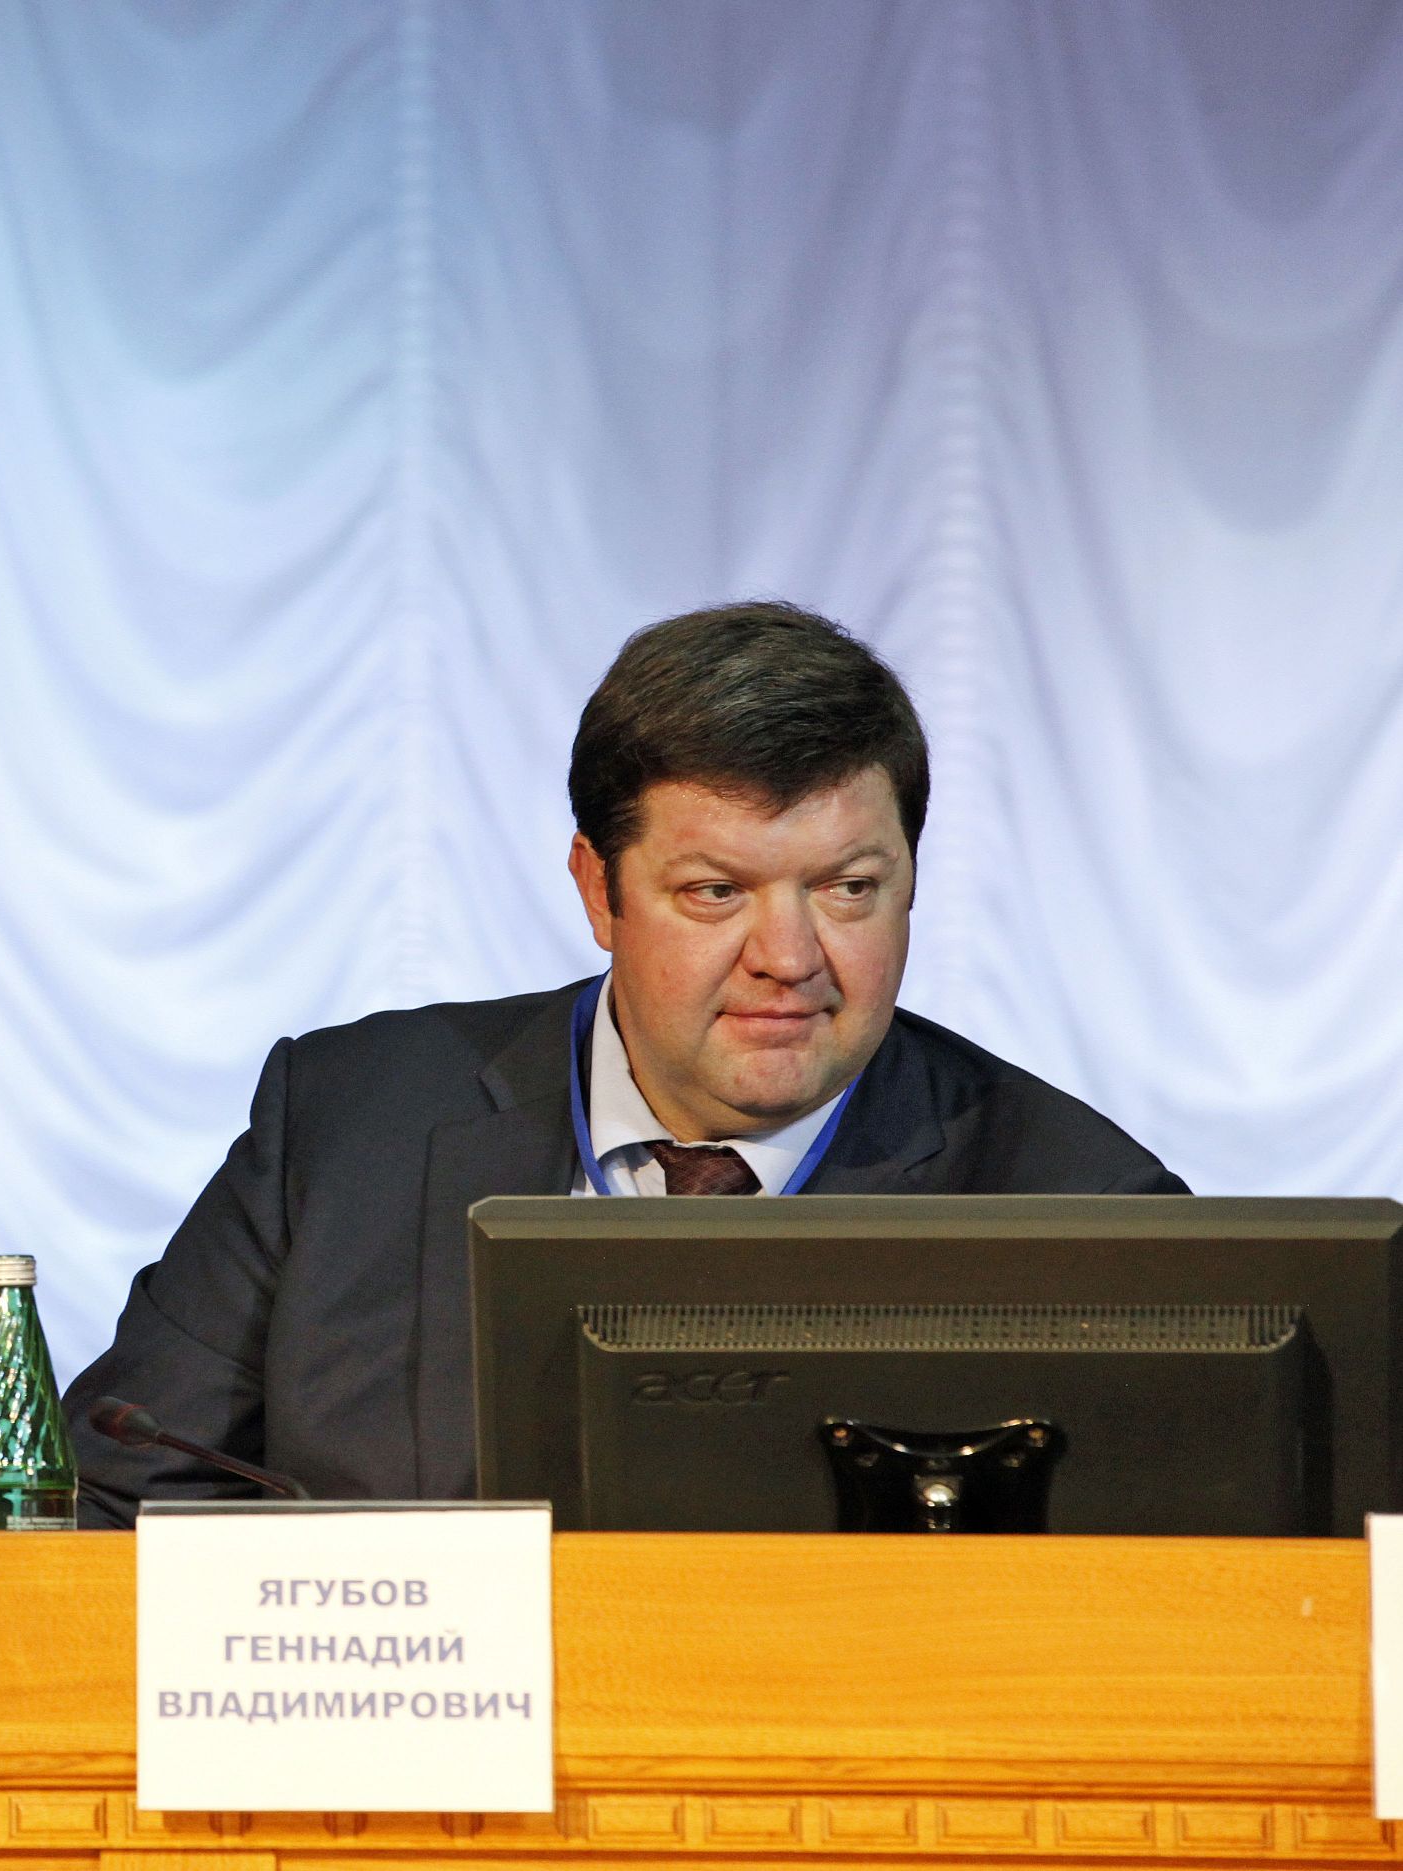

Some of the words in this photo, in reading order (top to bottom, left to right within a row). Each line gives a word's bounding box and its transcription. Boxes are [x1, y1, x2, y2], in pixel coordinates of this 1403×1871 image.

[259, 1579, 428, 1606] ЯГУБОВ
[224, 1629, 464, 1668] ГЕННАДИЙ
[158, 1691, 532, 1723] ВЛАДИМИРОВИЧ
